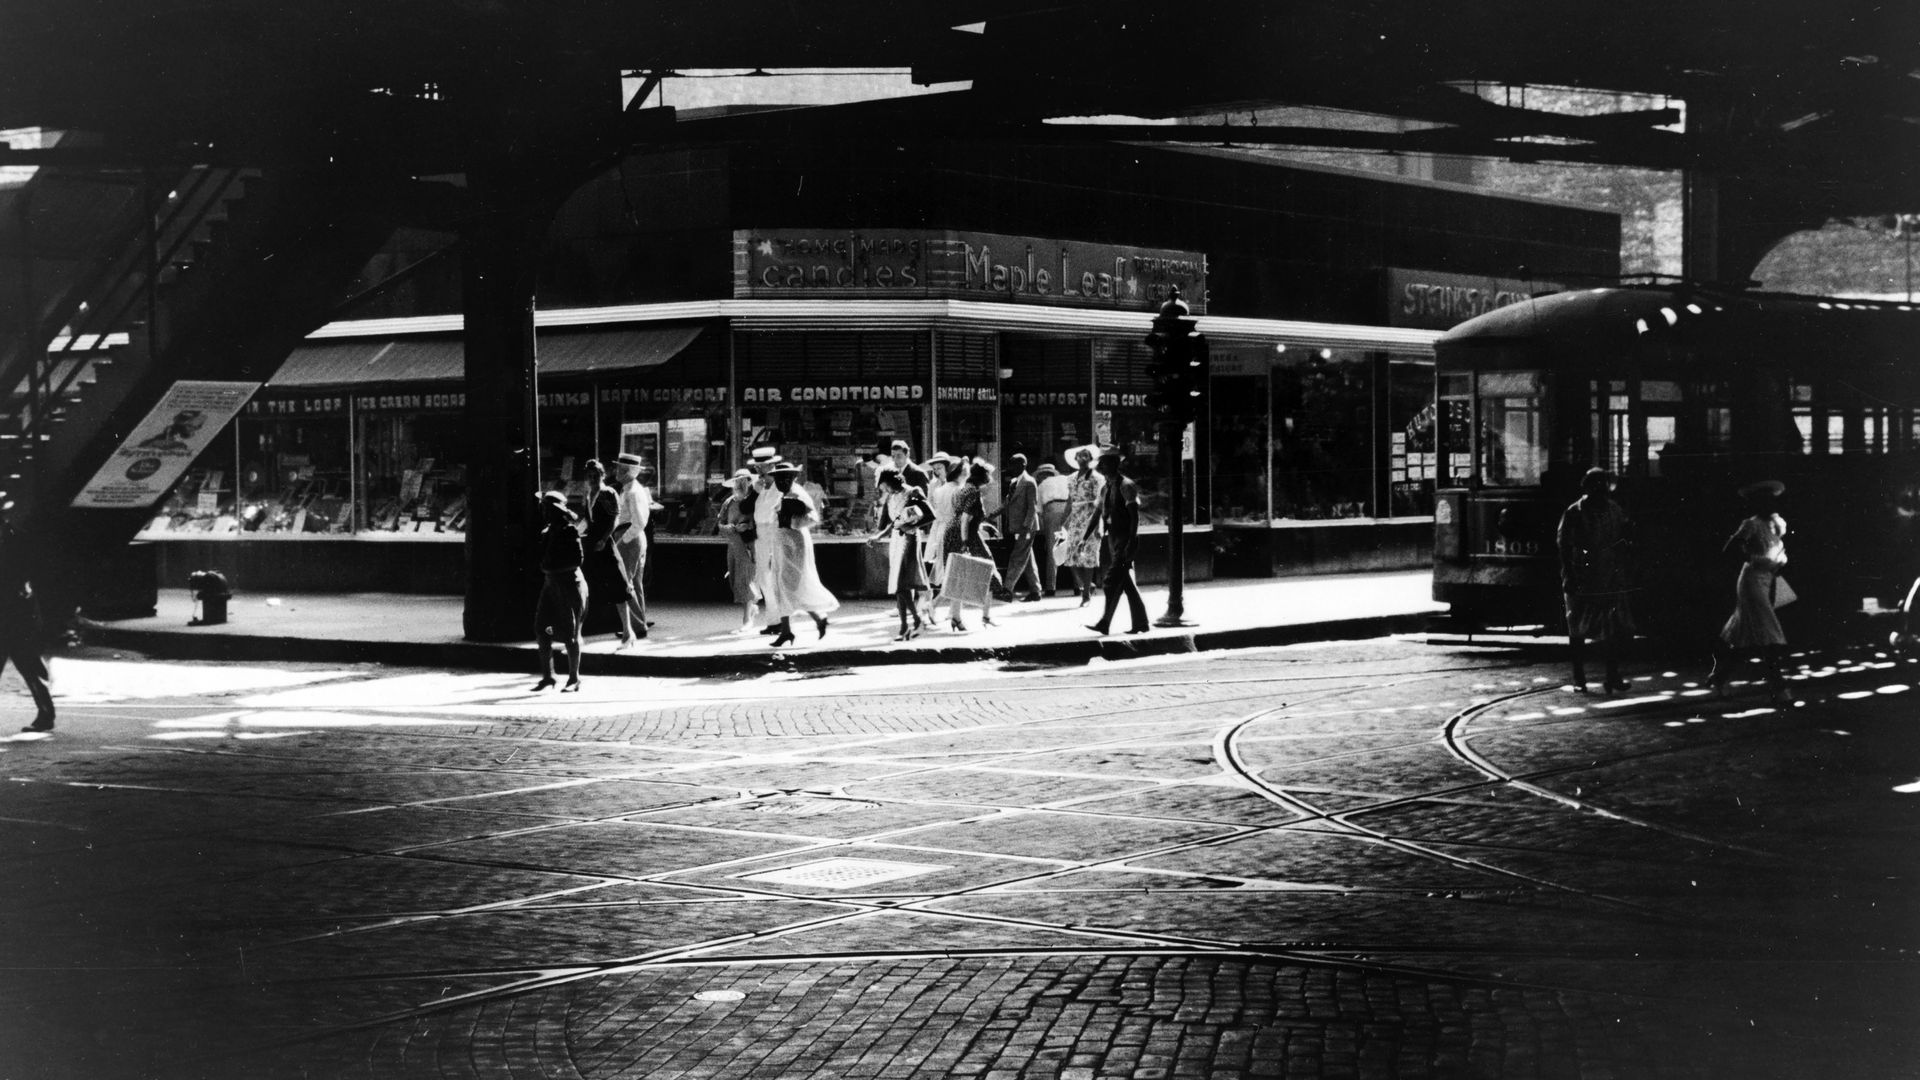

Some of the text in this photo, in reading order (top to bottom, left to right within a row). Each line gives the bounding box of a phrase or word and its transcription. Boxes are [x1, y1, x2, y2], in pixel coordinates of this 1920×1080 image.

[860, 239, 920, 255] MADE
[965, 243, 1127, 302] Maple Leaf
[537, 392, 590, 407] RINKS
[600, 386, 729, 403] EAT IN COMFORT
[743, 384, 925, 402] AIR CONDITIONED
[937, 386, 997, 402] SMARTEST GRILL
[1019, 392, 1089, 406] COMFORT
[1098, 391, 1119, 407] AIR
[267, 399, 296, 413] THE
[304, 397, 342, 412] LOOP
[356, 396, 376, 410] ICE
[379, 394, 421, 409] CREAM
